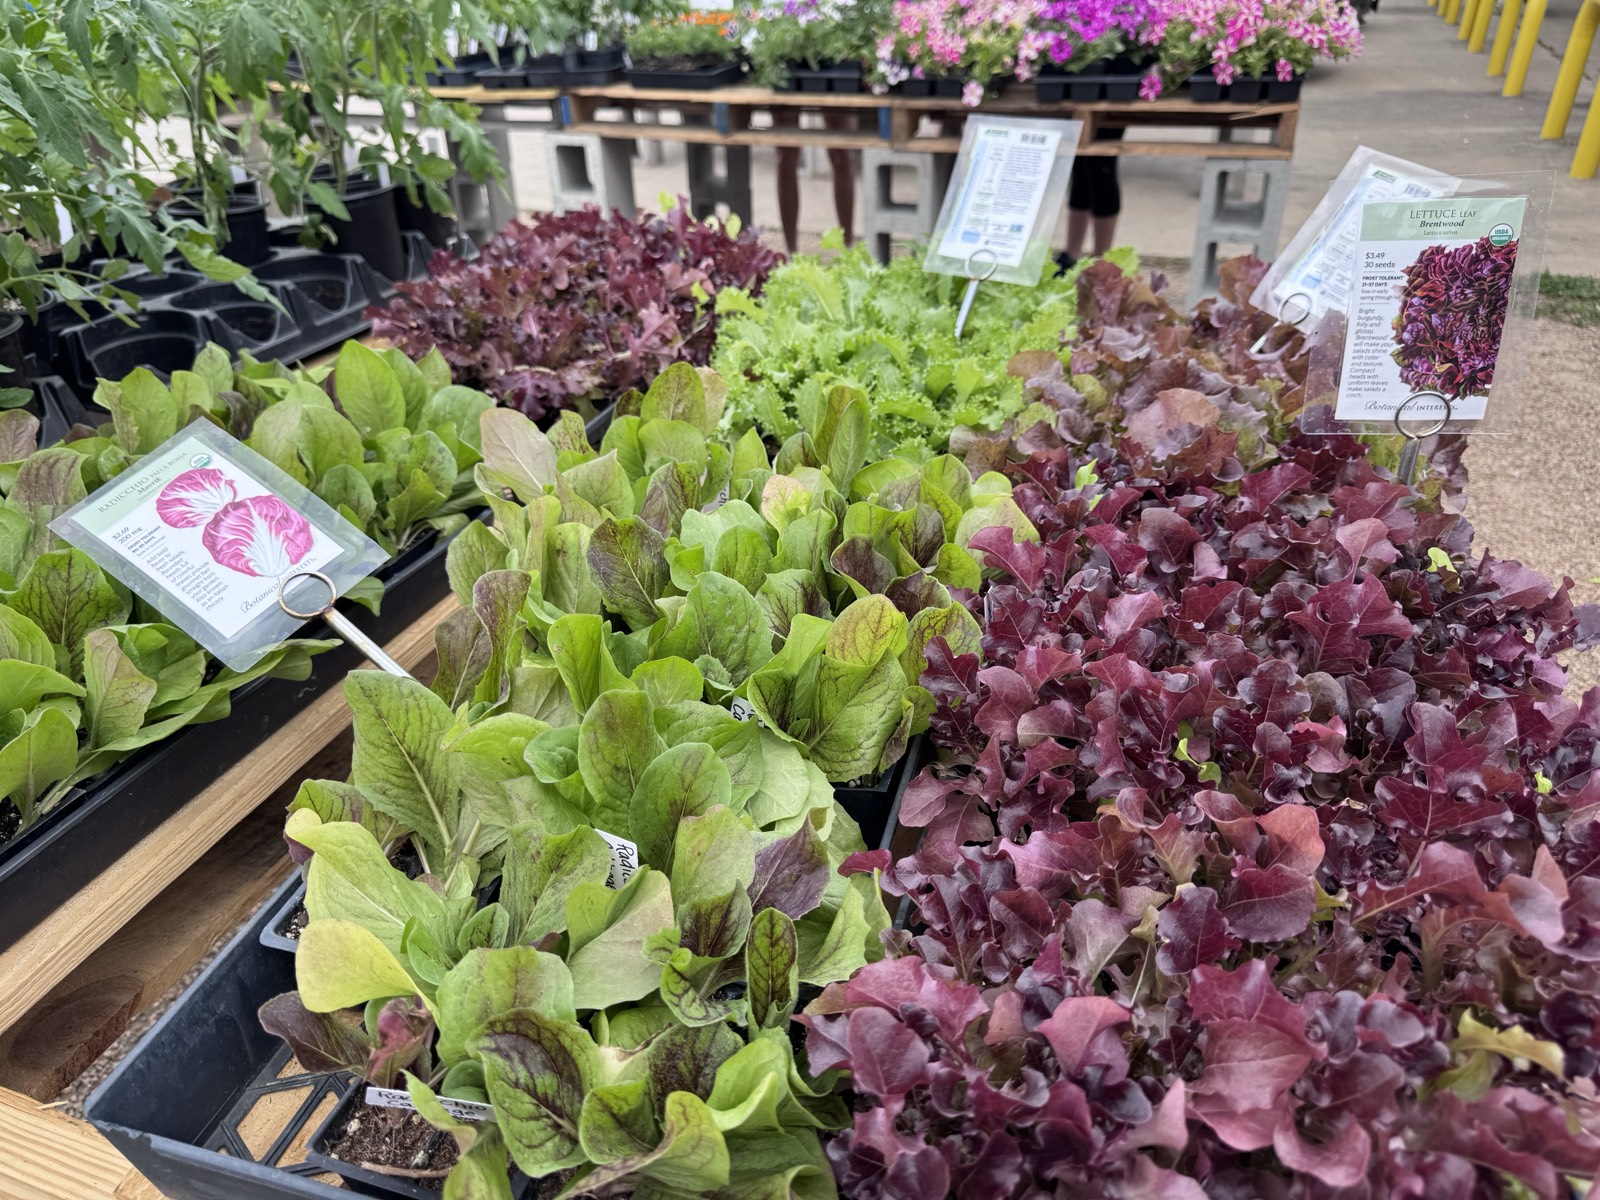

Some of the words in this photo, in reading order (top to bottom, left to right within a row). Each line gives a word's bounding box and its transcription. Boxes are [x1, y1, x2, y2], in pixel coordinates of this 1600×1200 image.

[1410, 210, 1456, 219] LETTUCE
[1419, 220, 1465, 228] Brentwood
[1366, 252, 1385, 260] $3.49
[138, 476, 161, 494] Mavrik
[98, 476, 150, 512] RADICCHIO
[113, 526, 130, 539] $2.69
[119, 533, 131, 543] 200
[128, 540, 140, 549] FROST
[141, 525, 160, 540] TOLERANT
[144, 535, 155, 544] DAYS
[146, 555, 157, 564] Add
[157, 546, 169, 556] bold
[151, 556, 165, 567] flavor
[156, 561, 169, 571] fresh
[161, 557, 183, 575] Rounded
[166, 567, 181, 578] heads
[176, 563, 195, 578] colorful
[176, 574, 191, 586] leaves
[191, 561, 210, 575] provide
[181, 574, 202, 591] gourmet
[201, 567, 211, 575] flair
[186, 580, 204, 594] straight
[203, 571, 215, 581] from
[191, 589, 204, 599] your
[195, 592, 207, 602] Also
[206, 580, 223, 594] known
[214, 584, 229, 596] Italian
[241, 576, 282, 613] Botanical
